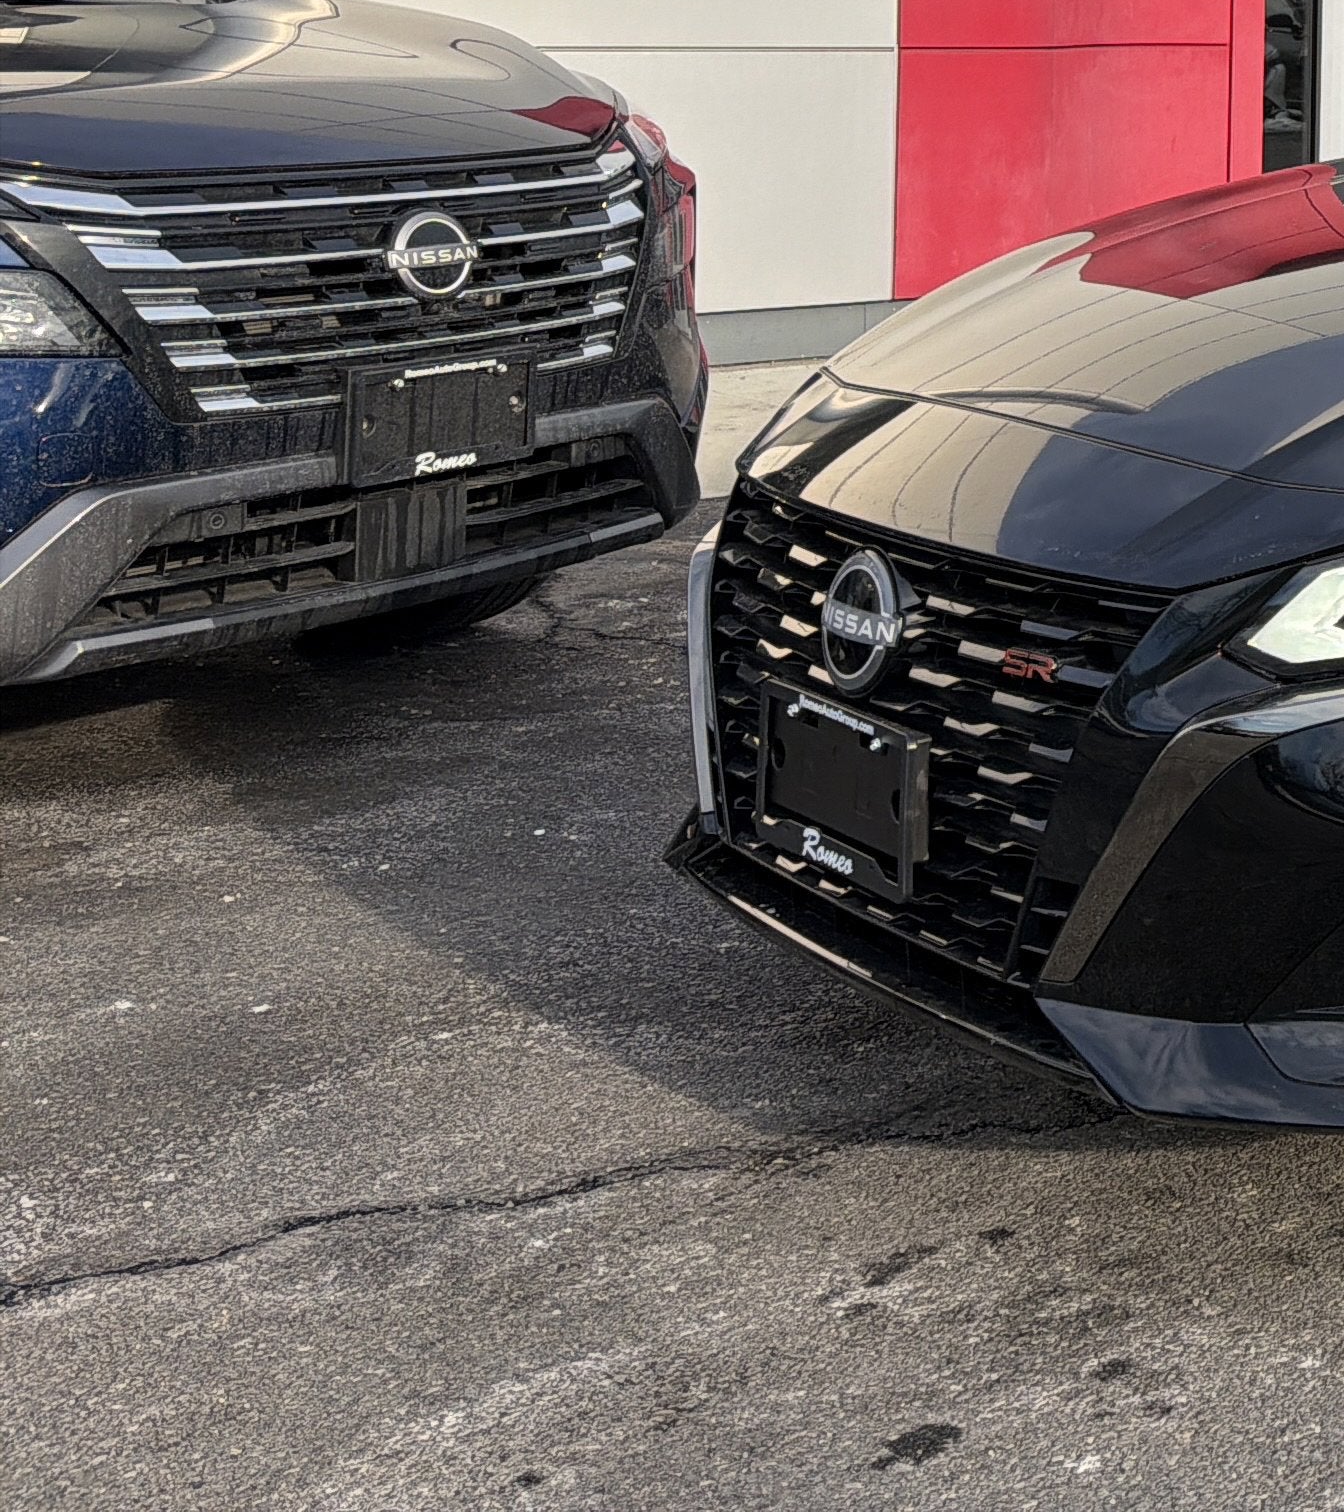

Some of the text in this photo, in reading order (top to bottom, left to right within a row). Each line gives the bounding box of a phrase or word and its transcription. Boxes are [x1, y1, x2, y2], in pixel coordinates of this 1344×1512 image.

[391, 245, 479, 266] NISSAN
[414, 451, 478, 477] Romeo
[824, 601, 896, 643] NISSAN
[1002, 648, 1056, 684] SR
[801, 827, 854, 876] Romeo
